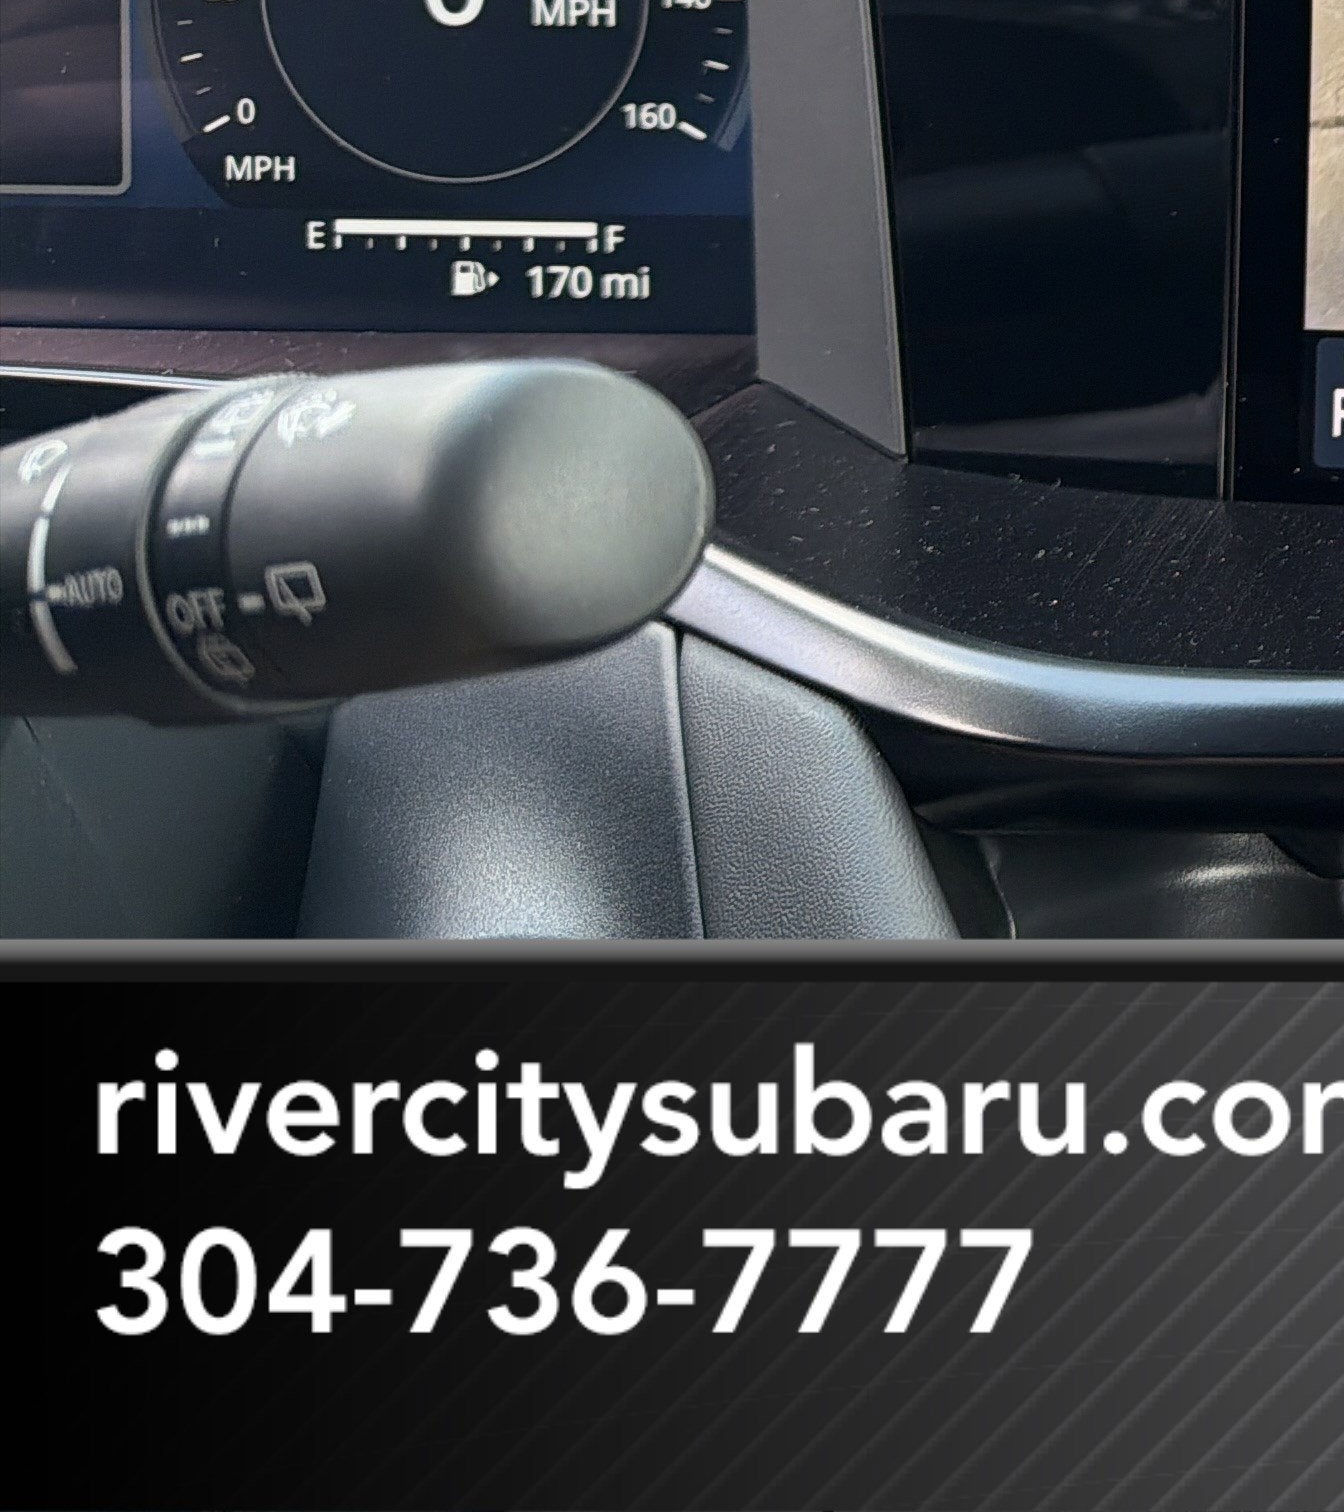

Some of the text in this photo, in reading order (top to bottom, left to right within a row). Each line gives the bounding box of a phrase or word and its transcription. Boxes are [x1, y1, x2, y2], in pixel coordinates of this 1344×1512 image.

[236, 98, 255, 123] 0
[623, 103, 676, 129] 160
[225, 155, 295, 182] MPH
[306, 221, 325, 248] E
[604, 222, 625, 248] F
[527, 266, 651, 299] 170 mi
[64, 566, 124, 608] AUTO
[165, 587, 225, 636] OFF
